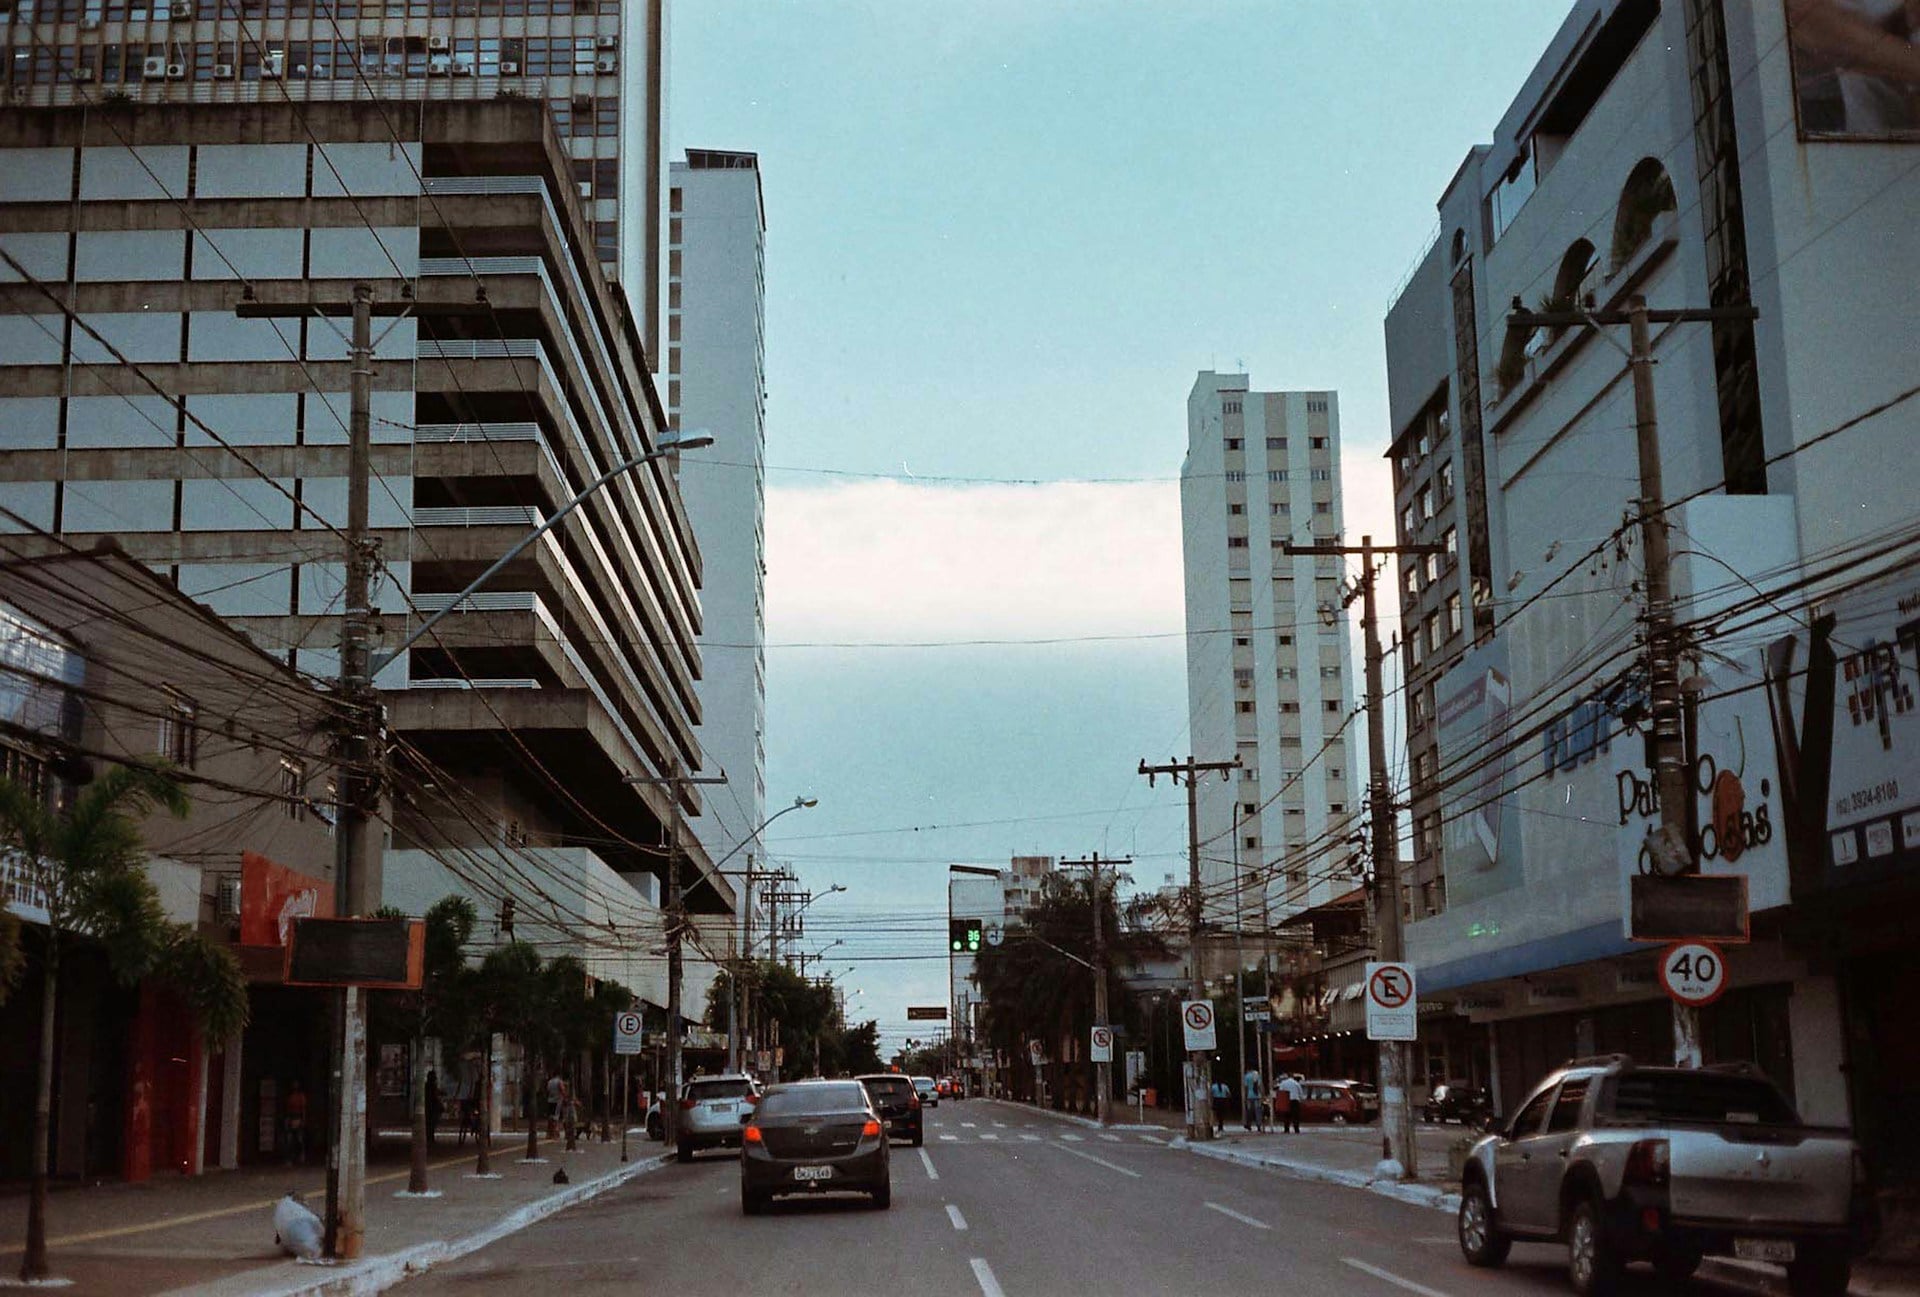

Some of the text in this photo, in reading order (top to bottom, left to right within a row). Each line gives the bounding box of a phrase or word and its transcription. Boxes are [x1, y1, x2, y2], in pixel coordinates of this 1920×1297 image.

[1671, 953, 1715, 982] 40
[1385, 976, 1399, 997] E
[626, 1018, 634, 1031] E
